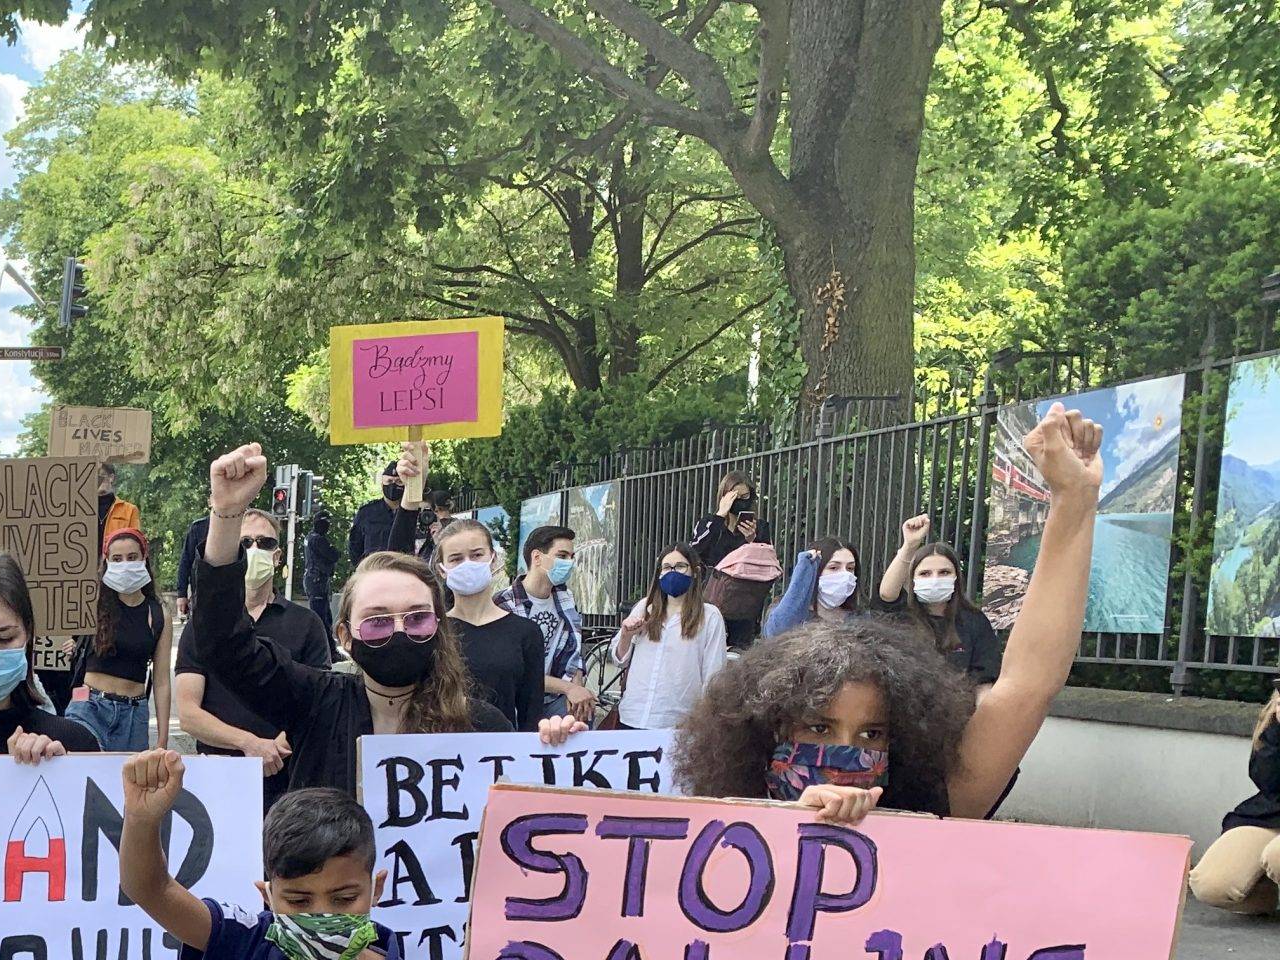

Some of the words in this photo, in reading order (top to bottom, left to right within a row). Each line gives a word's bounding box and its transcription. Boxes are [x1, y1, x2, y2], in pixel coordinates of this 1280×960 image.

[380, 387, 444, 412] LEPSI
[58, 411, 112, 428] BLACK
[72, 428, 122, 442] LIVES
[376, 754, 469, 829] BE
[499, 812, 879, 942] STOP
